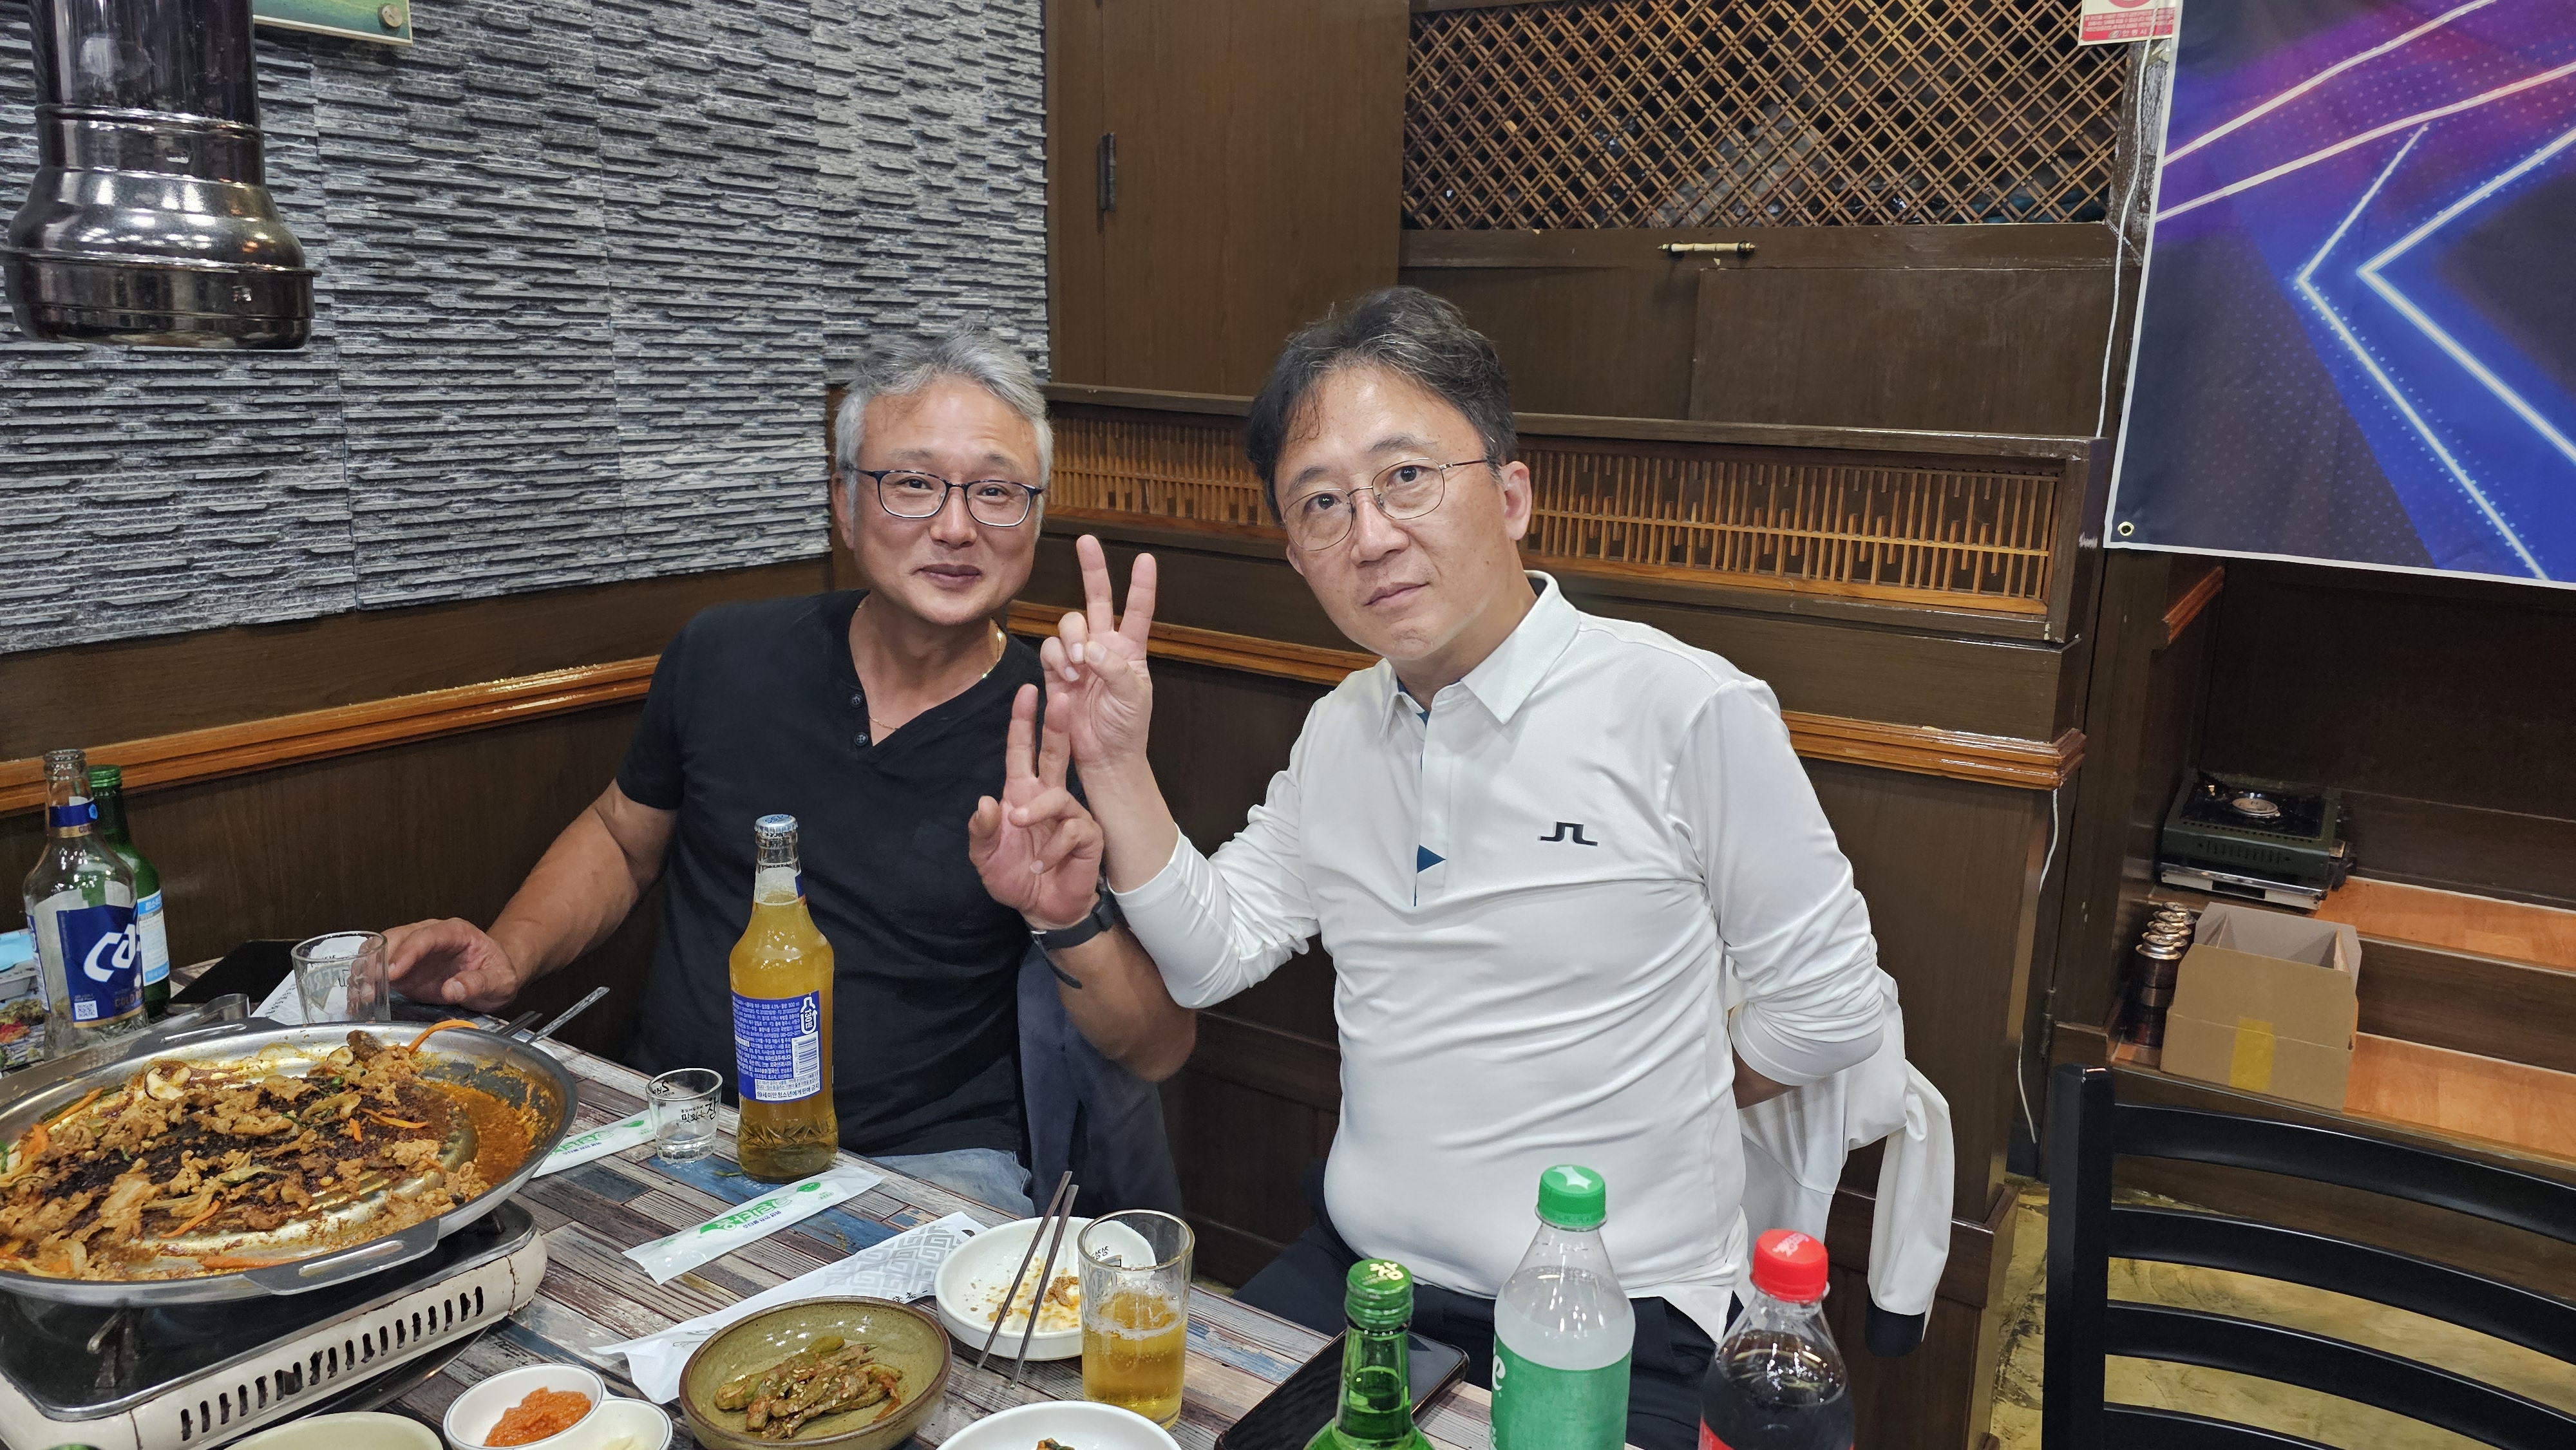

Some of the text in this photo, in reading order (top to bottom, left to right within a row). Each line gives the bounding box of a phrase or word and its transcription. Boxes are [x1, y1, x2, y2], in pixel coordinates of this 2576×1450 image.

[804, 1008, 813, 1029] 130원
[681, 1096, 719, 1125] 맛있는 참
[1368, 1261, 1405, 1281] 참
